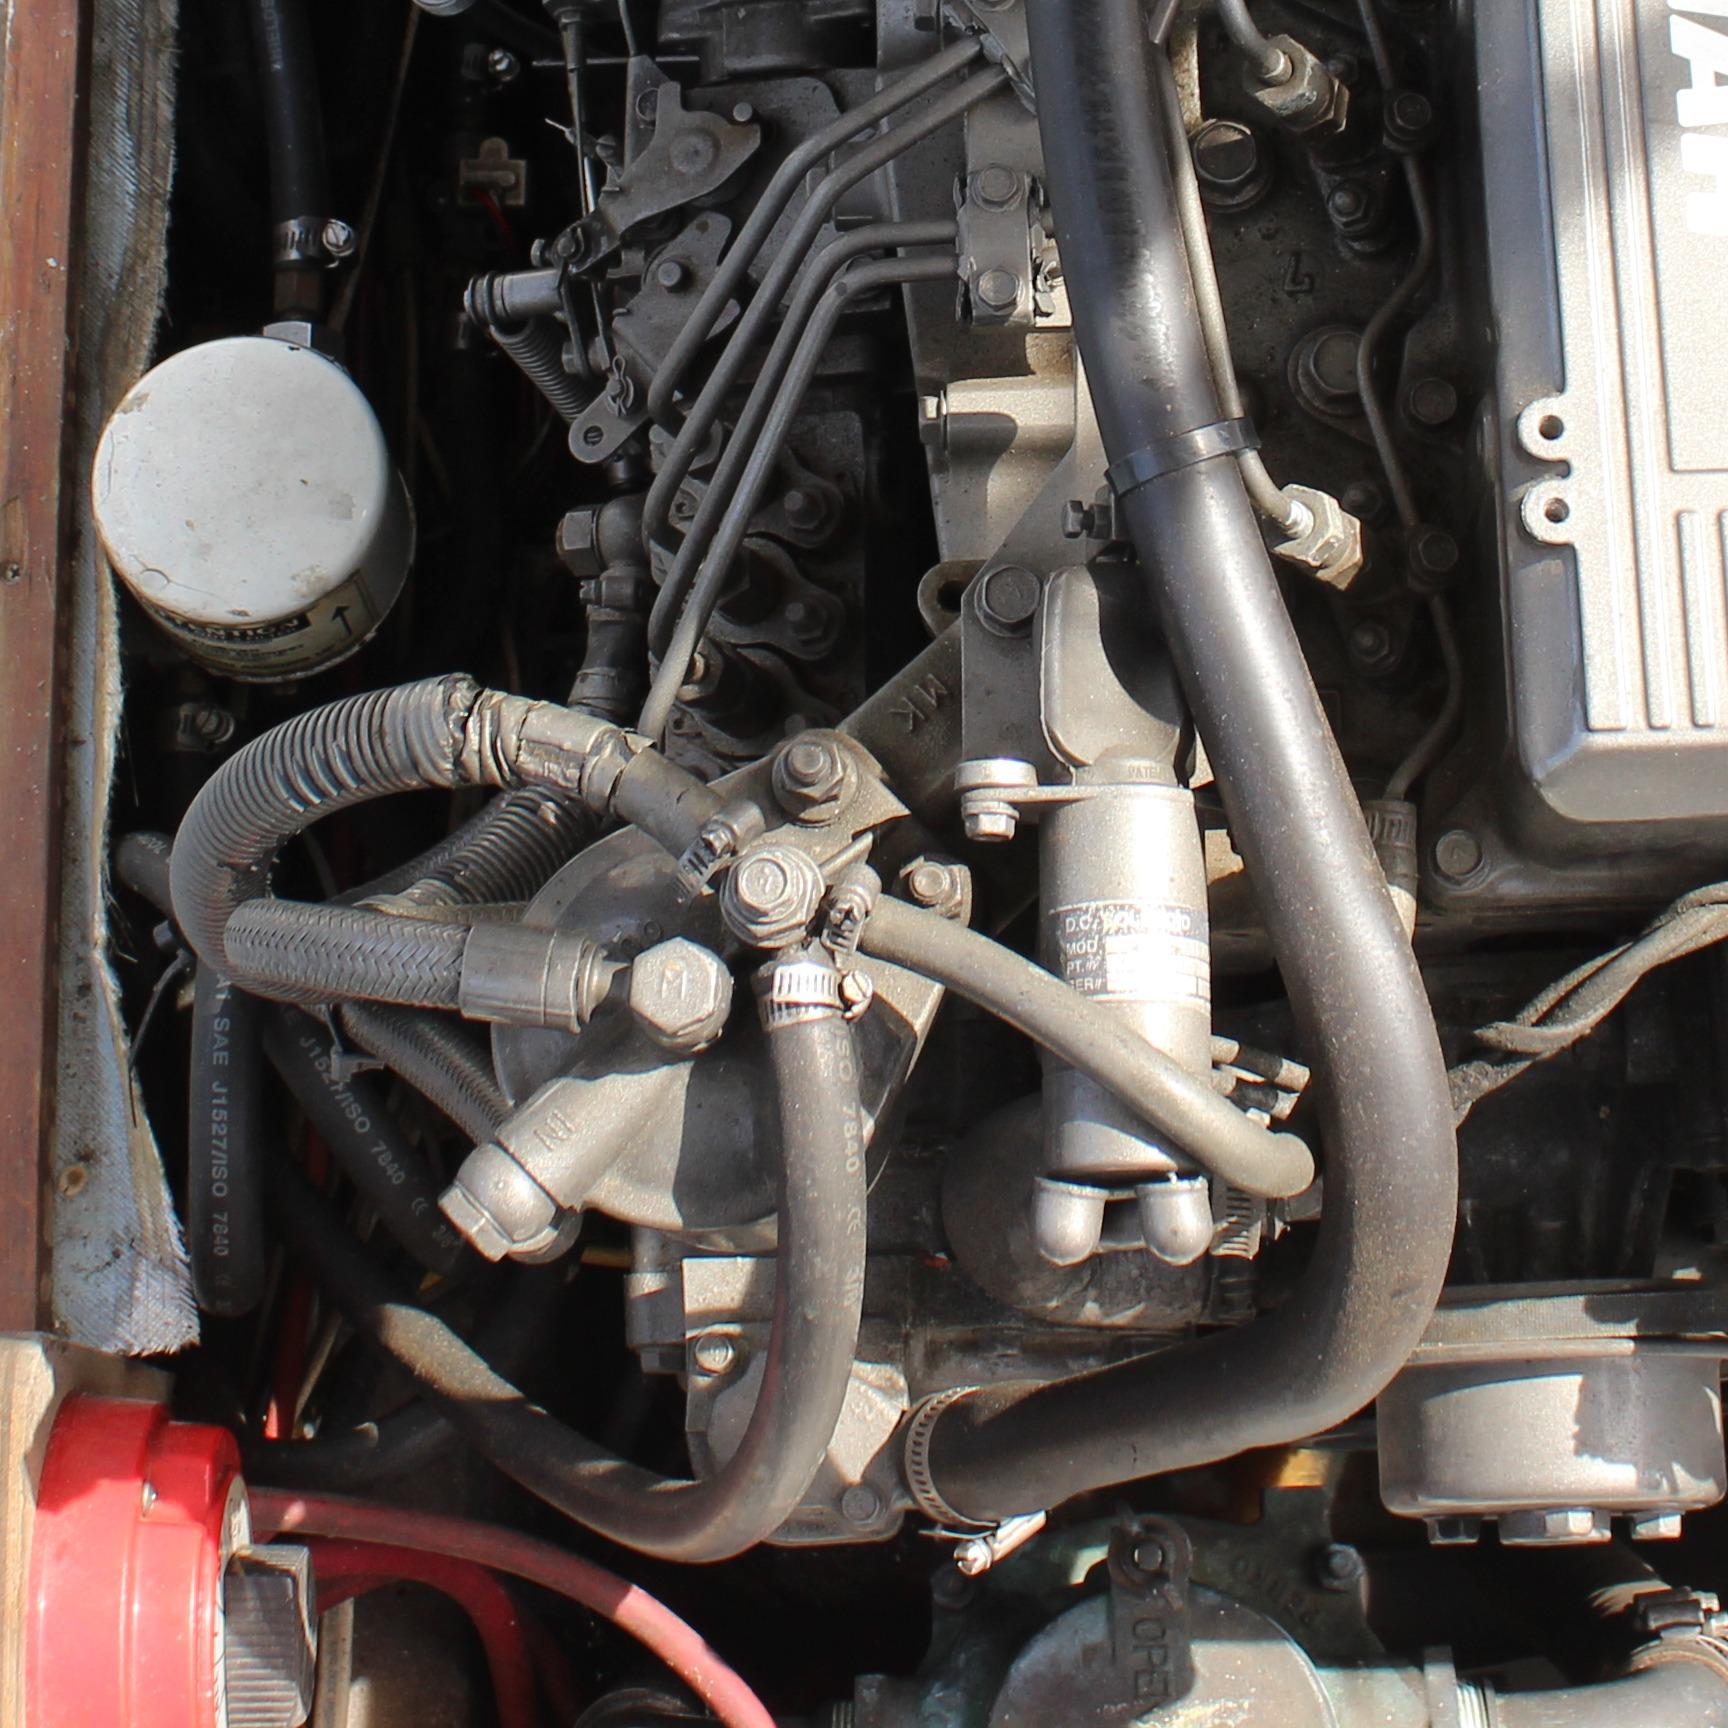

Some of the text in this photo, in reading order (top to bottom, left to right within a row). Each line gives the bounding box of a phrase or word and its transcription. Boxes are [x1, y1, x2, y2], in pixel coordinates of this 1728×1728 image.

[212, 1018, 230, 1066] SAE
[211, 1081, 229, 1198] J1527/ISO
[843, 1101, 860, 1172] 7840
[369, 1140, 408, 1187] 7840
[212, 1212, 229, 1256] 7840
